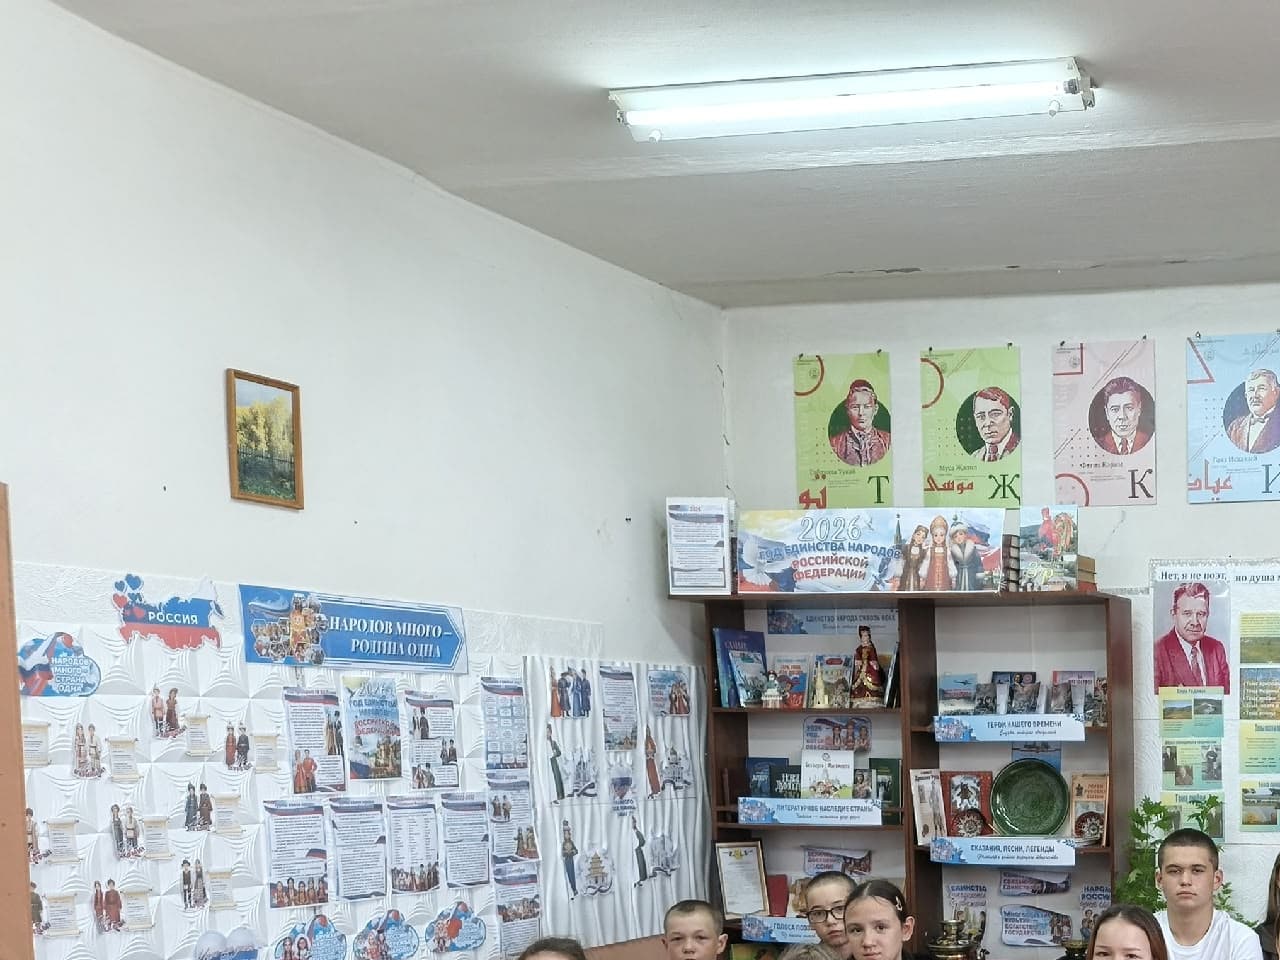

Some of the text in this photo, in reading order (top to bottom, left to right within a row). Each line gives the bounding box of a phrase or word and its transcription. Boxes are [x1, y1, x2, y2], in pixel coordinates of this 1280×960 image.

[867, 475, 890, 504] Т
[1128, 468, 1154, 498] К
[798, 515, 861, 542] 2026
[759, 541, 900, 561] ГОД ЕДИНСТВА НАРОДОВ
[792, 553, 869, 570] РОССИЙСКОЙ
[793, 567, 866, 581] ФЕДЕРАЦИИ
[1161, 571, 1180, 581] Нет,
[1204, 572, 1228, 581] поэт,
[1249, 574, 1275, 584] душа
[148, 611, 198, 625] РОССИЯ
[330, 616, 393, 635] НАРОДОВ
[396, 622, 442, 638] МНОГО
[351, 638, 441, 658] РОДИНА ОДНА
[54, 666, 82, 674] МНОГО
[55, 675, 86, 683] СТРАНА
[1007, 720, 1031, 728] НАШЕГО
[1033, 720, 1062, 728] ВРЕМЕНИ
[777, 804, 818, 812] ЛИТЕРАТУРНОЕ
[820, 804, 849, 812] НАСЛЕДИЕ
[1025, 845, 1055, 853] ЛЕГЕНДЫ
